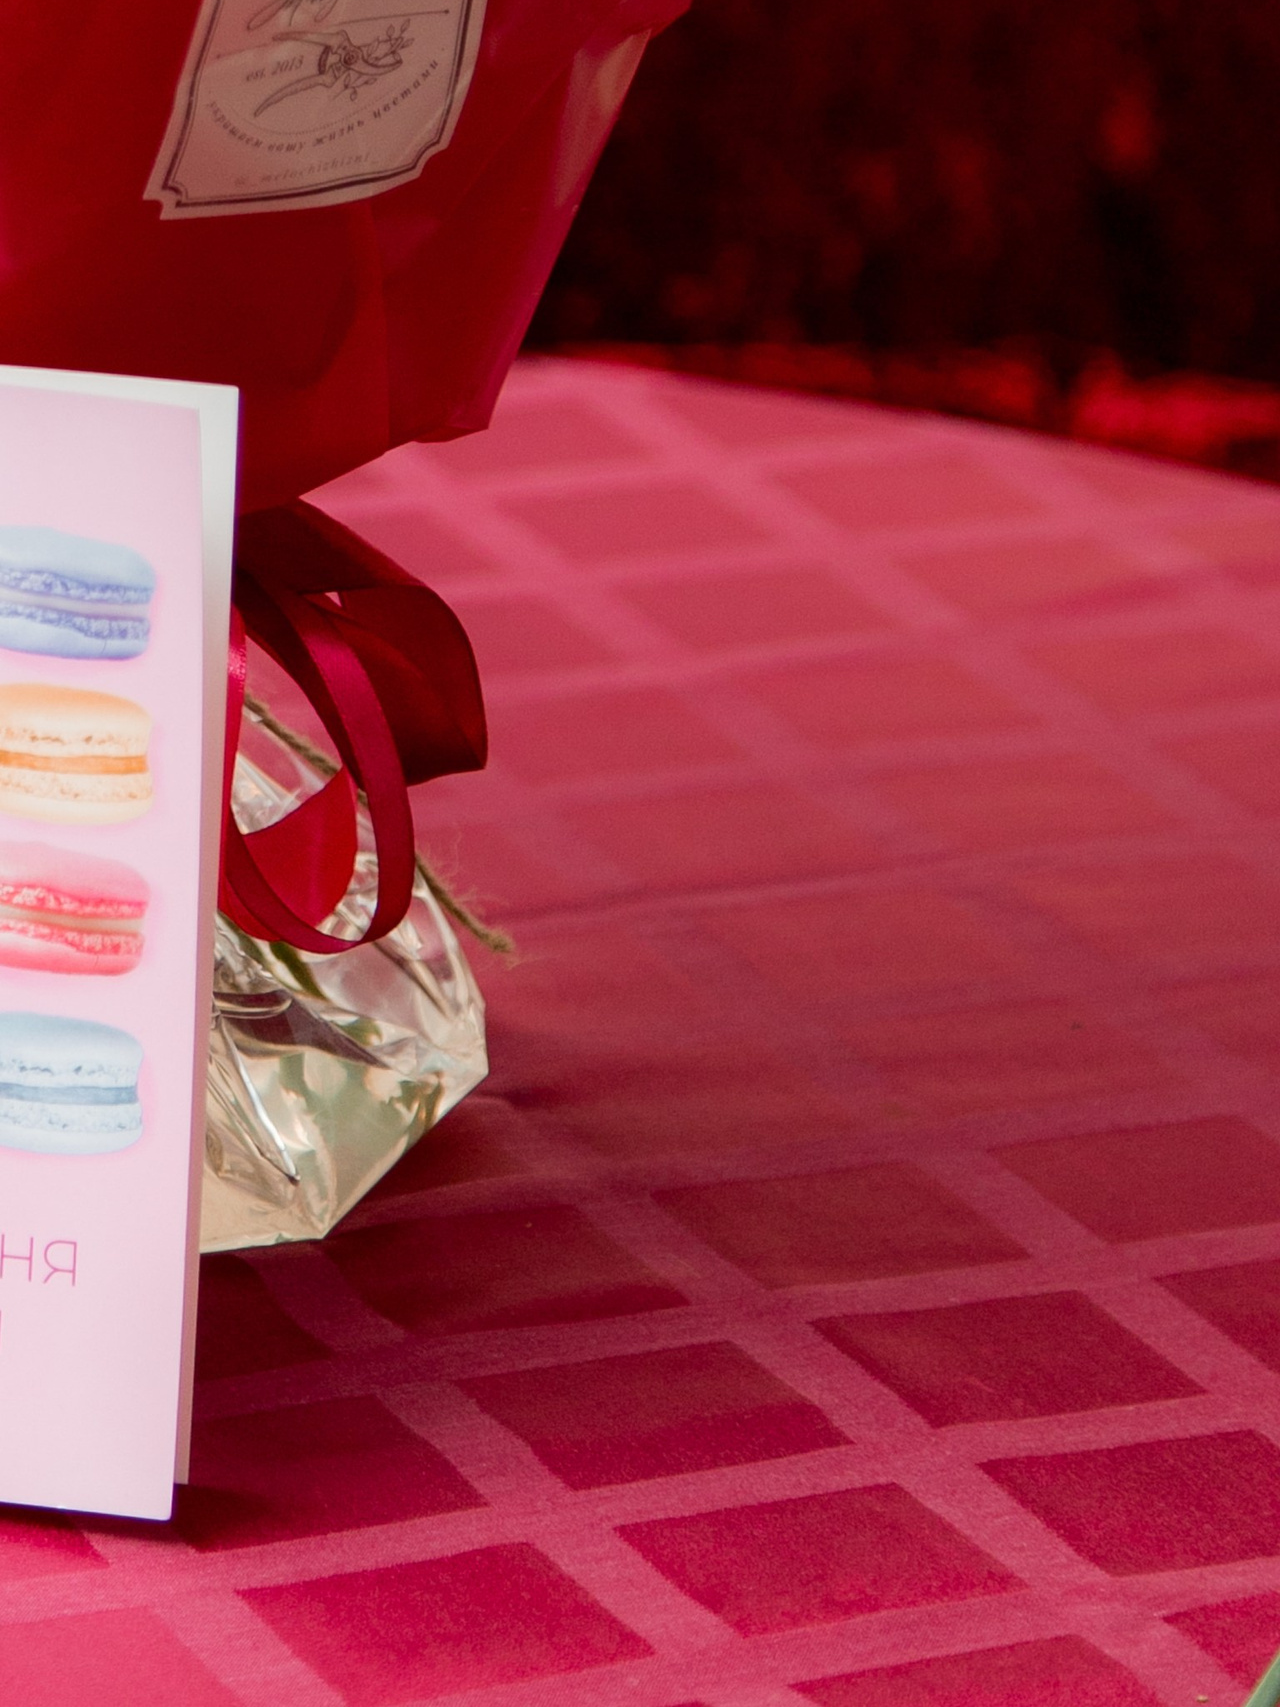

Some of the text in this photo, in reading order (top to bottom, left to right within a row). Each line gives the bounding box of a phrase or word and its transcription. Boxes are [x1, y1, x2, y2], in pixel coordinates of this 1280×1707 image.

[271, 55, 305, 75] 2013
[313, 118, 365, 146] жизнь
[372, 60, 439, 120] цветами
